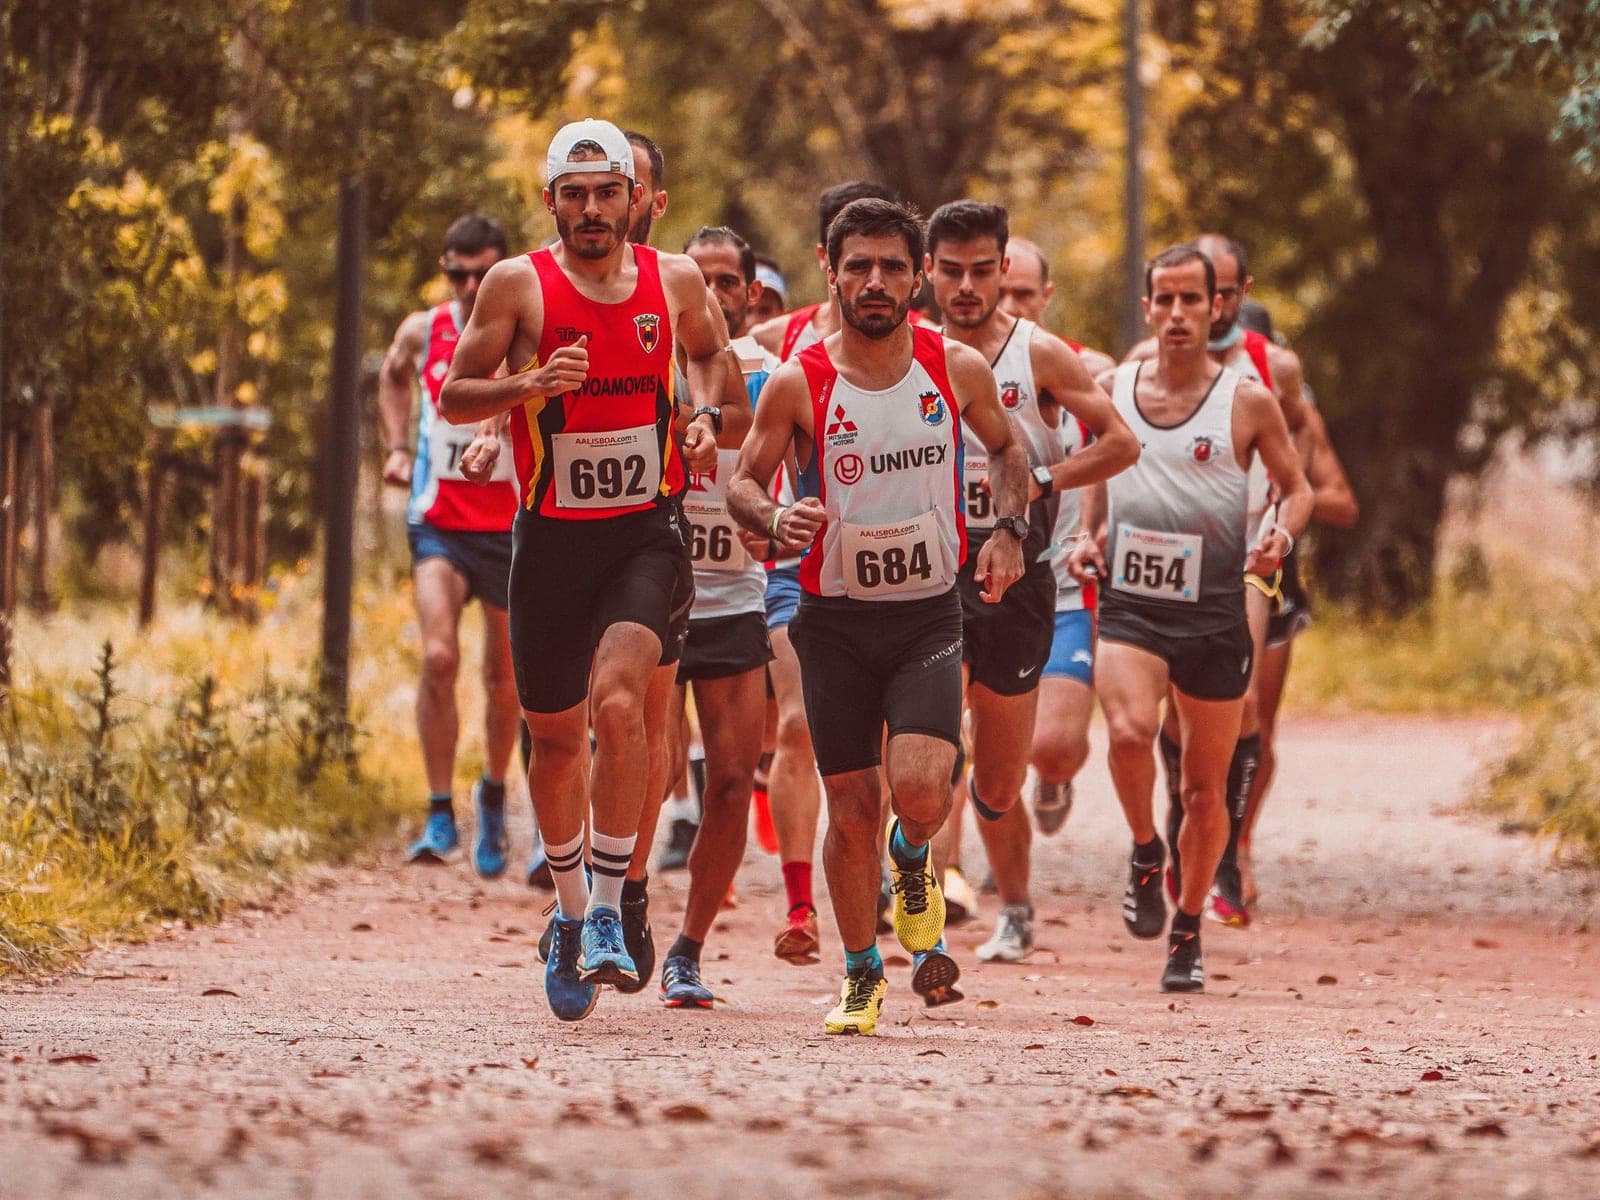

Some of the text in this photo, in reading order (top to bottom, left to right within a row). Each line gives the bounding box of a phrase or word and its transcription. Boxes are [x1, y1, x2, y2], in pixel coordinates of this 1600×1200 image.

[575, 435, 632, 445] AALISBOA.com
[870, 443, 947, 474] UNIVEX
[570, 454, 647, 499] 692
[690, 524, 732, 562] 66
[860, 524, 915, 538] AALISBOA.com
[855, 540, 932, 589] 684
[1124, 550, 1187, 593] 654
